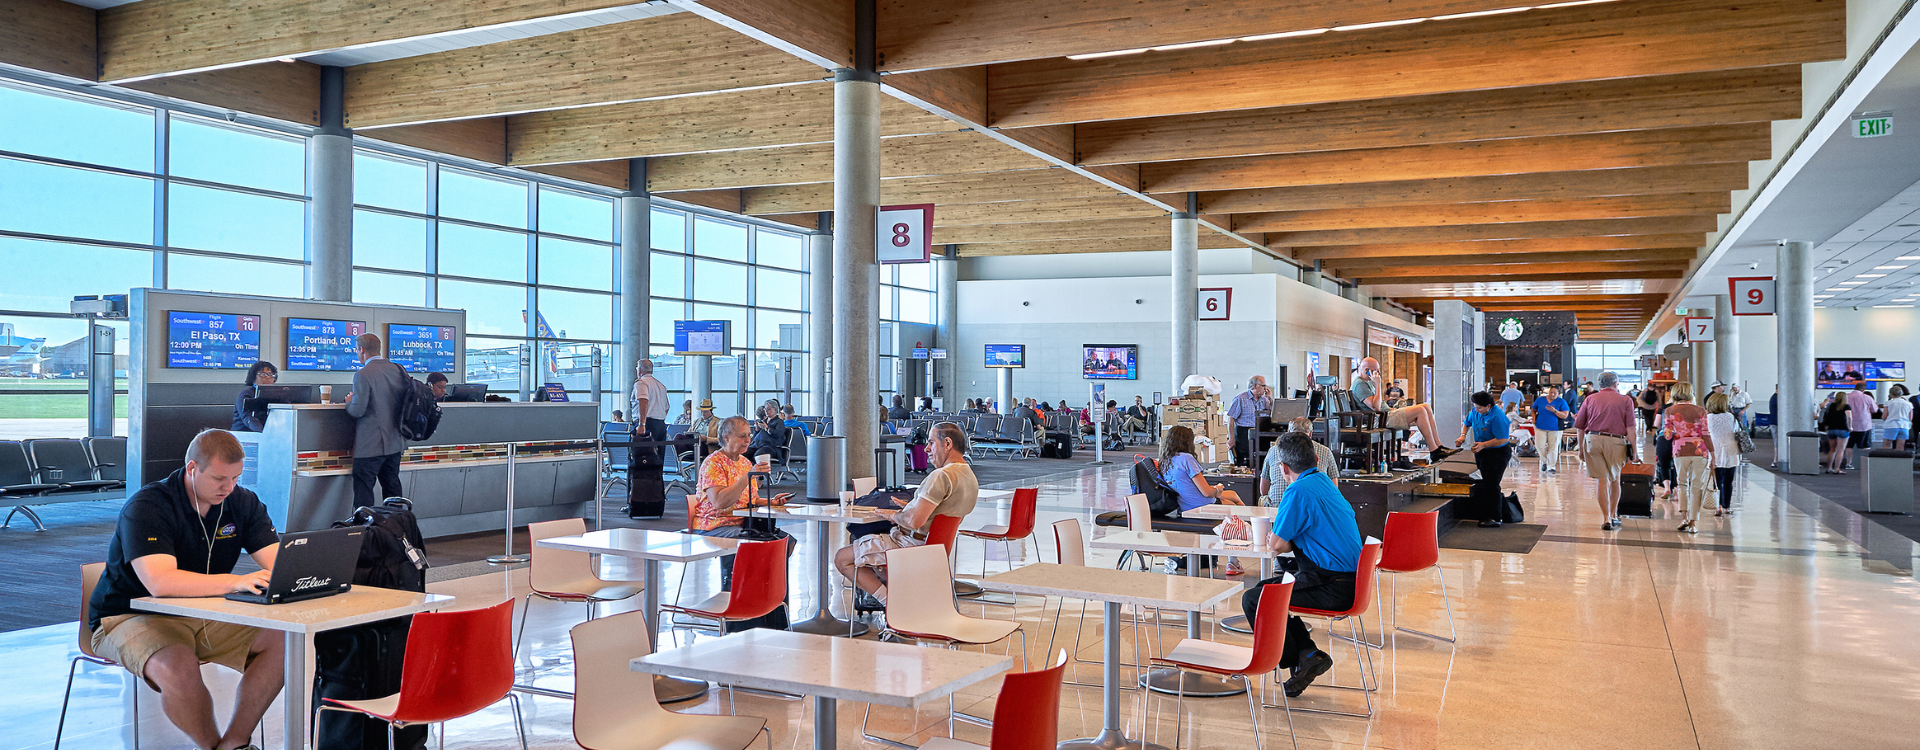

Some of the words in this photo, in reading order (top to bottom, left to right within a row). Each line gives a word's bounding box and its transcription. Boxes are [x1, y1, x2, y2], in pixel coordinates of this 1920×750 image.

[1860, 119, 1887, 136] EXIT
[892, 222, 910, 247] 8
[1748, 288, 1764, 304] 9
[1206, 298, 1218, 311] 6
[242, 322, 253, 330] 10
[1698, 324, 1706, 335] 7
[202, 332, 226, 341] Paso,
[304, 336, 338, 346] Portland,
[403, 341, 432, 349] Lubbock,
[291, 576, 331, 592] Titleist
